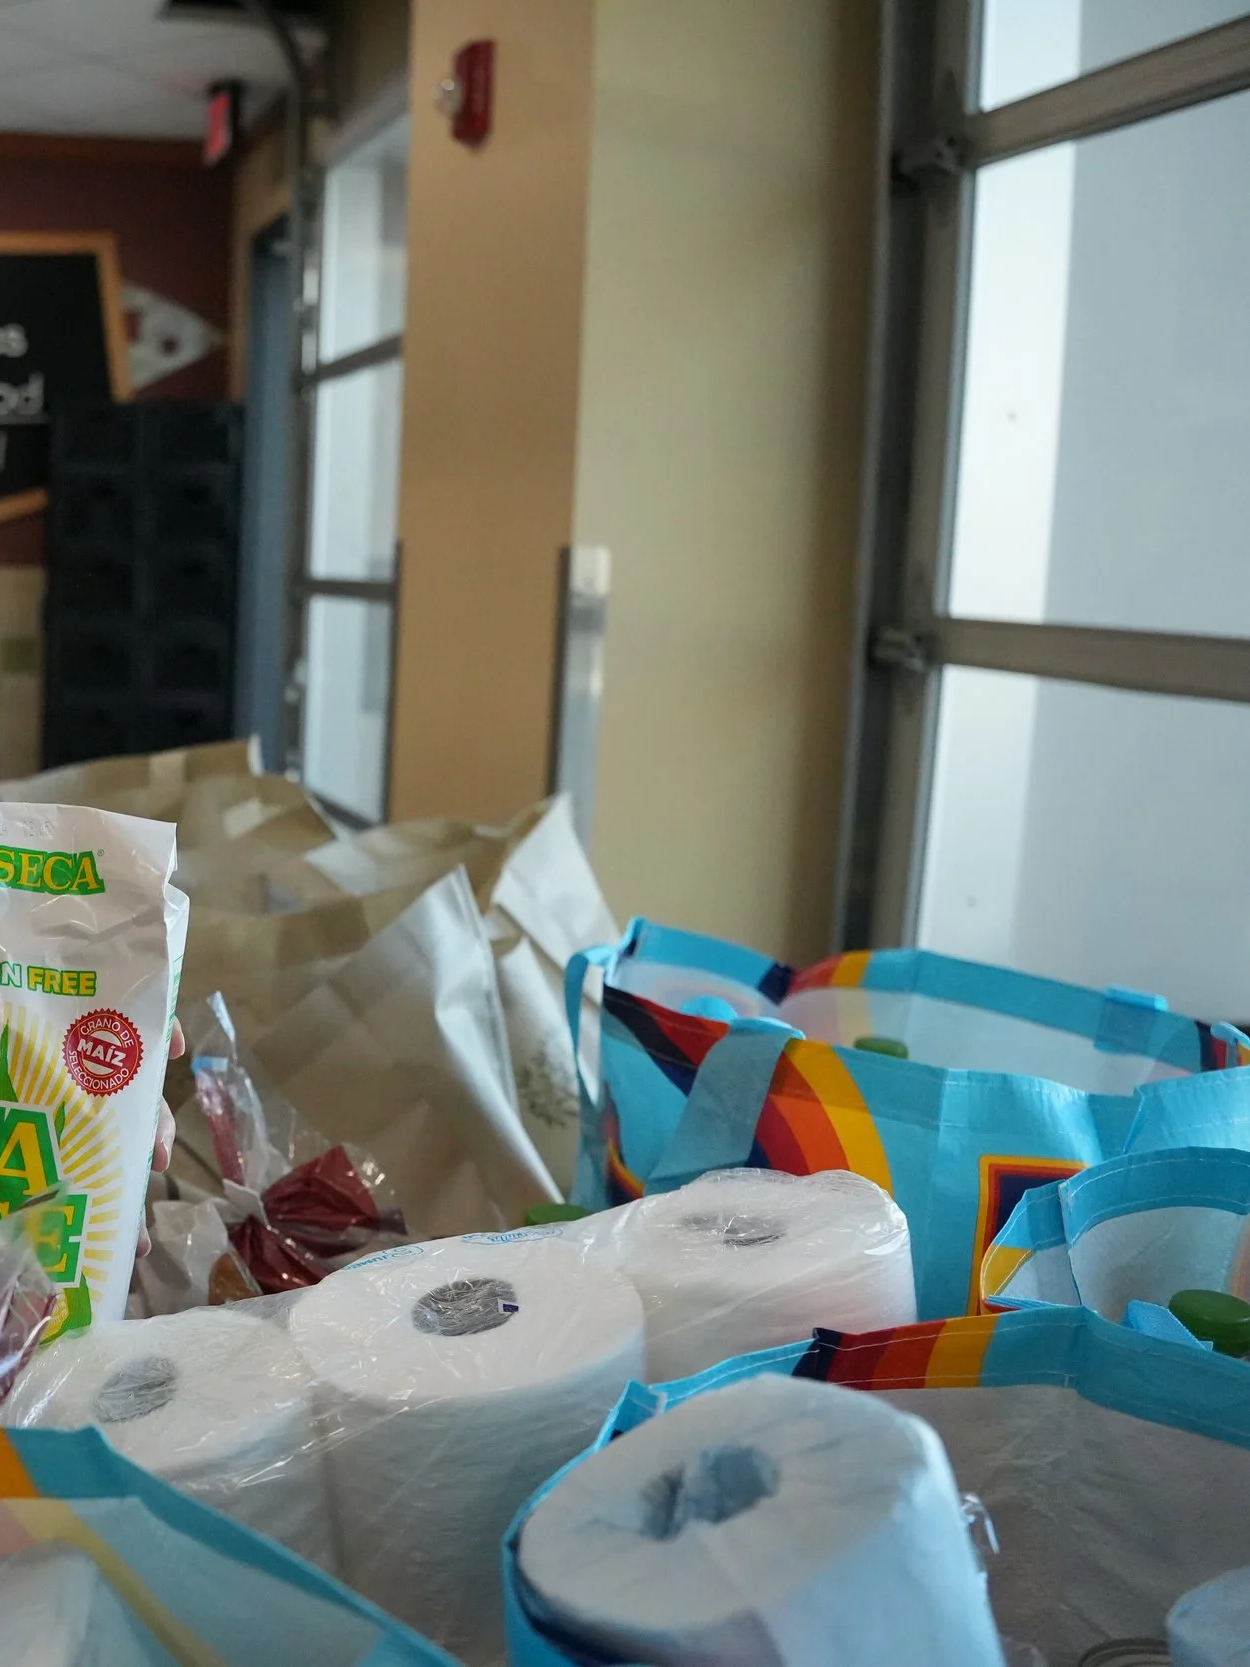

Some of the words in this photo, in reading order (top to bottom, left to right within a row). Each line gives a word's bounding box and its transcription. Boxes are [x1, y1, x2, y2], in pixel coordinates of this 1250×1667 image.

[27, 966, 97, 997] FREE
[81, 1018, 121, 1036] GRANO
[120, 1030, 134, 1048] DE
[77, 1038, 127, 1067] MAÍZ
[69, 1050, 129, 1089] SELECCIONADO
